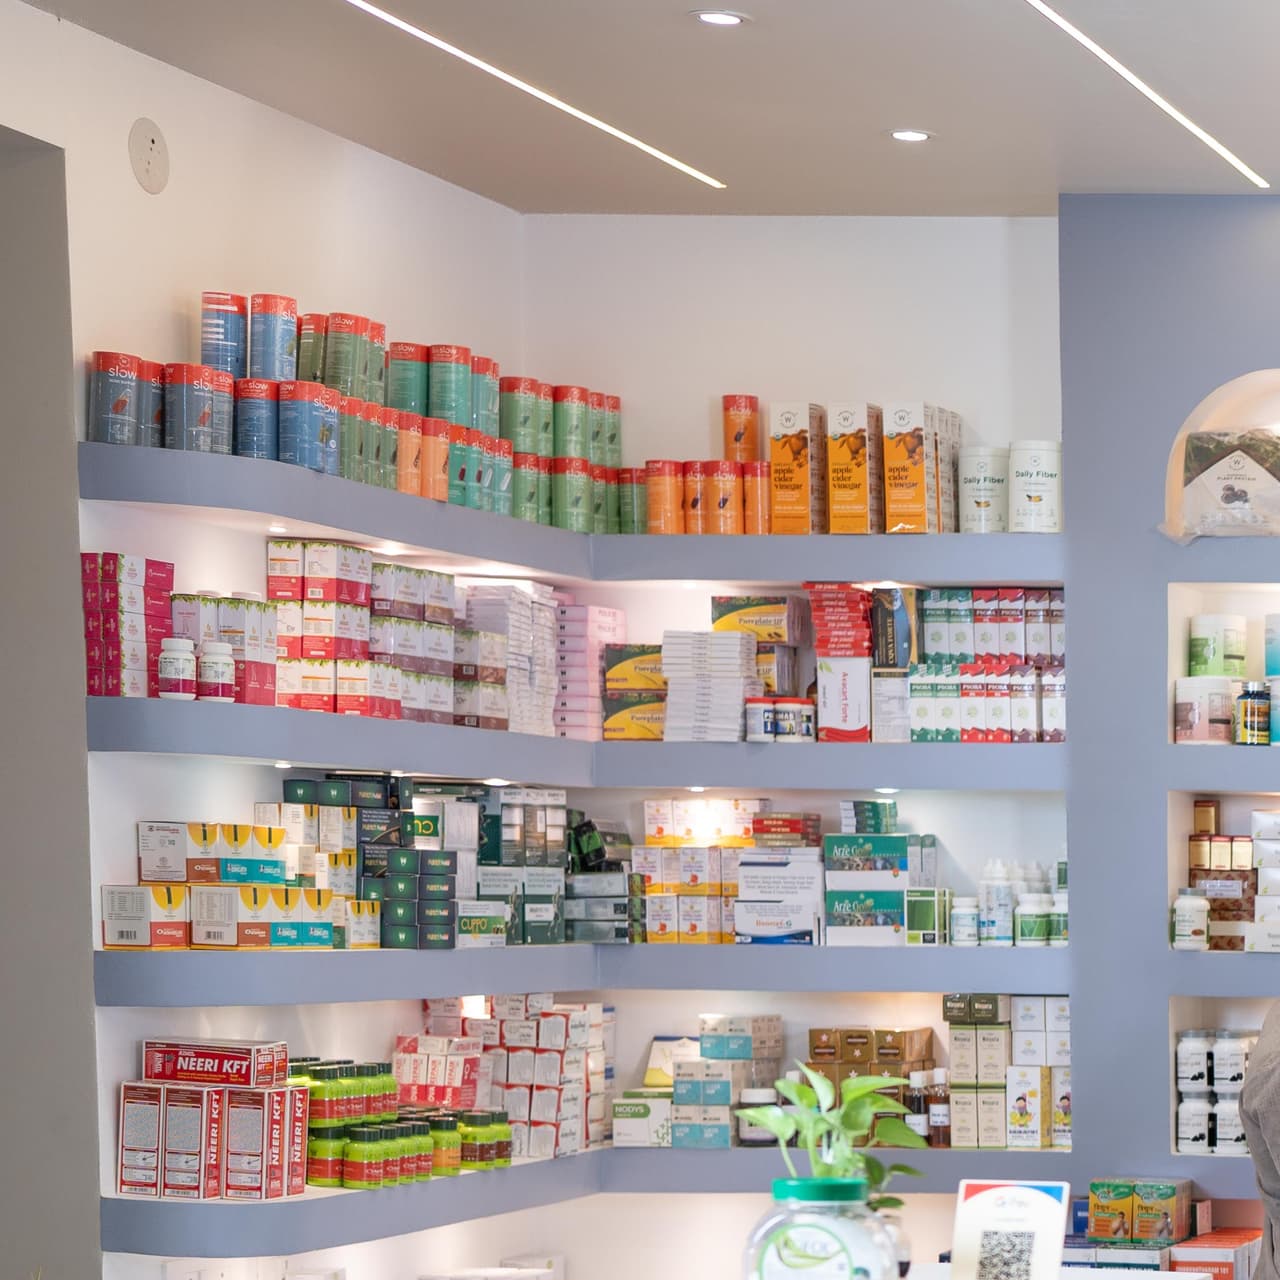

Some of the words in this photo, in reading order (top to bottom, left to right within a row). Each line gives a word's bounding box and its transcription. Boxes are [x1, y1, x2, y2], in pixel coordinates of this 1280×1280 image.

[773, 466, 795, 476] apple
[832, 466, 853, 476] apple
[888, 465, 910, 475] apple
[1016, 470, 1034, 480] Daily
[1036, 470, 1057, 479] Fiber
[773, 474, 794, 483] cider
[832, 474, 852, 483] cider
[888, 473, 909, 482] cider
[963, 476, 981, 486] Daily
[983, 476, 1005, 485] Fiber
[773, 482, 803, 492] vinegar
[832, 482, 861, 492] vinegar
[888, 480, 918, 490] vinegar
[177, 1056, 218, 1073] NEERI
[222, 1060, 249, 1074] KFT
[210, 1092, 219, 1119] KFT
[272, 1093, 282, 1119] KFT
[294, 1091, 304, 1118] KFT
[208, 1124, 219, 1165] NEERI
[271, 1125, 281, 1165] NEERI
[293, 1121, 303, 1162] NEERI
